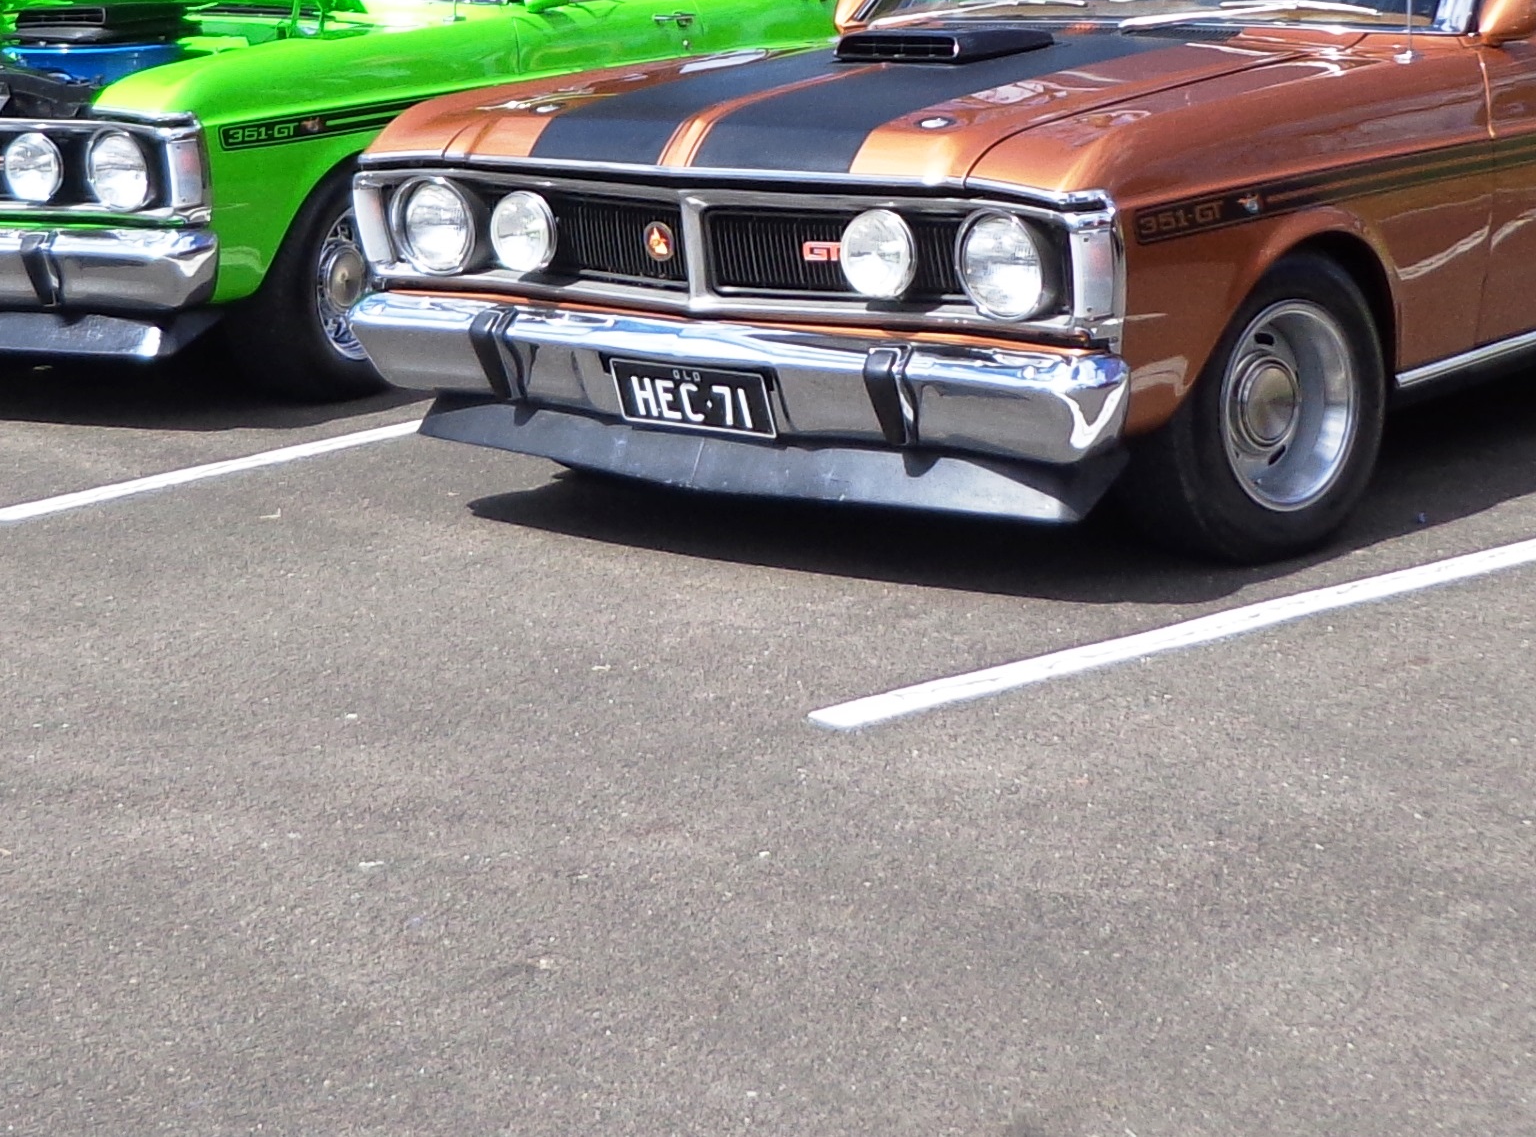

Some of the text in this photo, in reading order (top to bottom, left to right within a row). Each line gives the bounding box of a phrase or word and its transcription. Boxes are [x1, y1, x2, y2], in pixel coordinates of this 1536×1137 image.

[228, 123, 299, 143] 351-GT
[1140, 201, 1223, 234] 351-GT
[803, 241, 842, 261] GT
[672, 369, 701, 382] QLD
